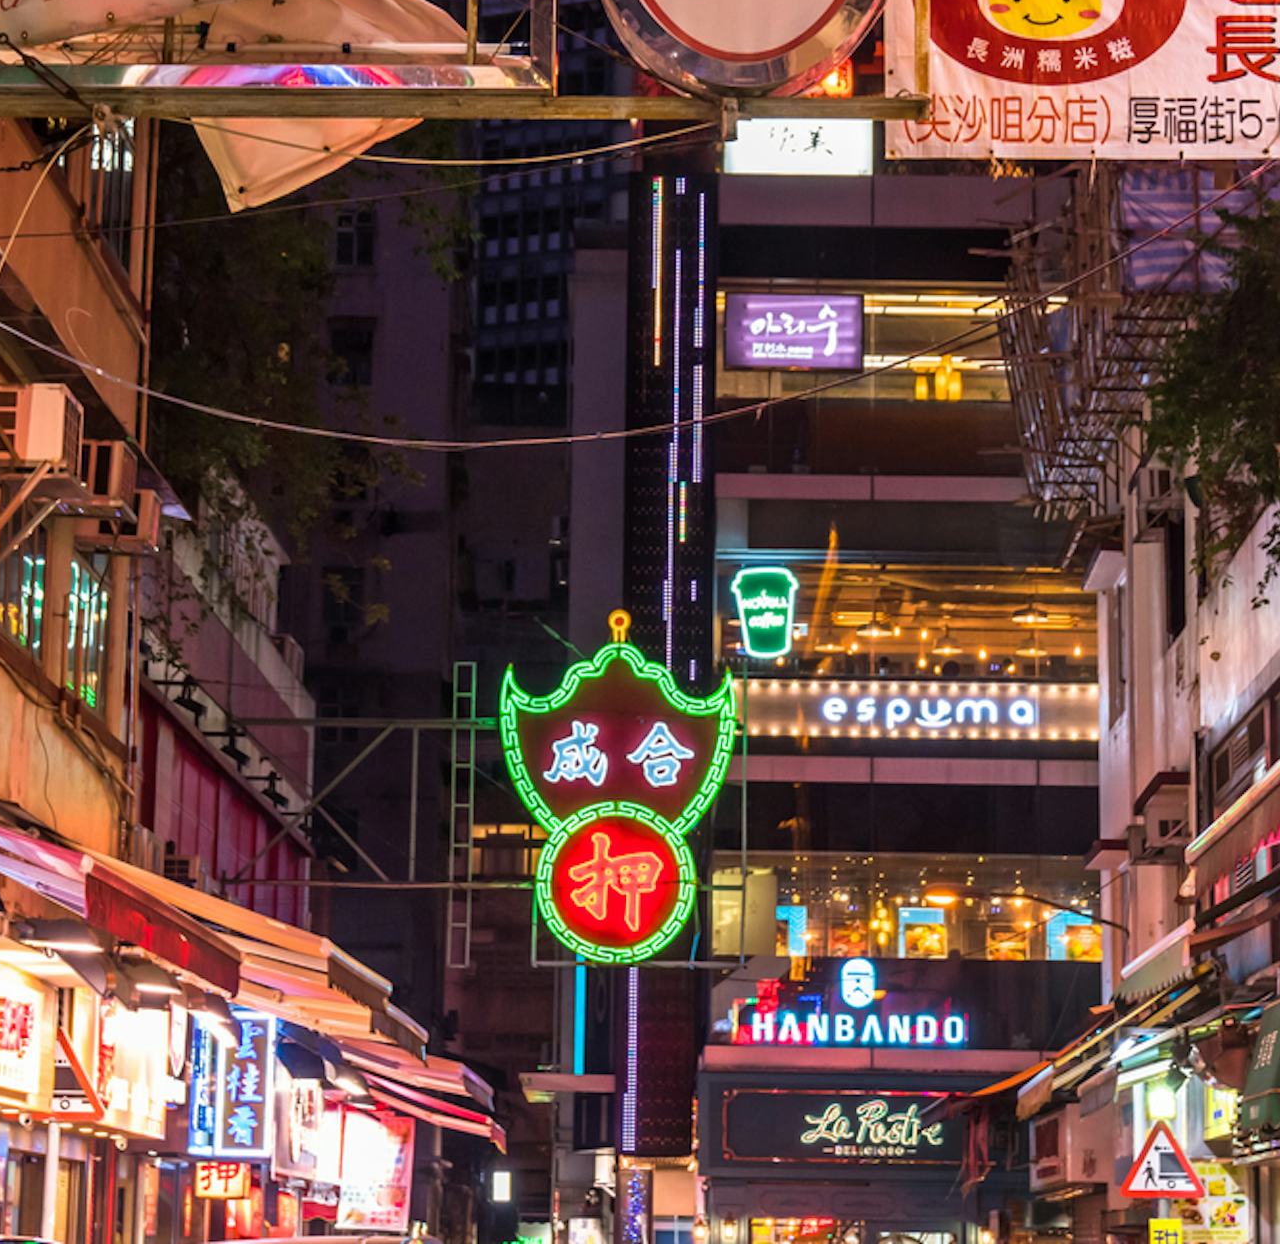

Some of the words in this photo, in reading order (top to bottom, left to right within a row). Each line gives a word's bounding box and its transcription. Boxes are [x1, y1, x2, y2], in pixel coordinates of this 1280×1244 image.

[750, 302, 839, 357] 아리수
[822, 695, 1035, 731] espuma
[568, 831, 664, 933] 押
[751, 1012, 965, 1045] HANBANDO
[800, 1103, 854, 1145] La
[856, 1098, 944, 1147] Postre
[834, 1144, 905, 1157] DELICIOSO
[199, 1162, 241, 1194] 押
